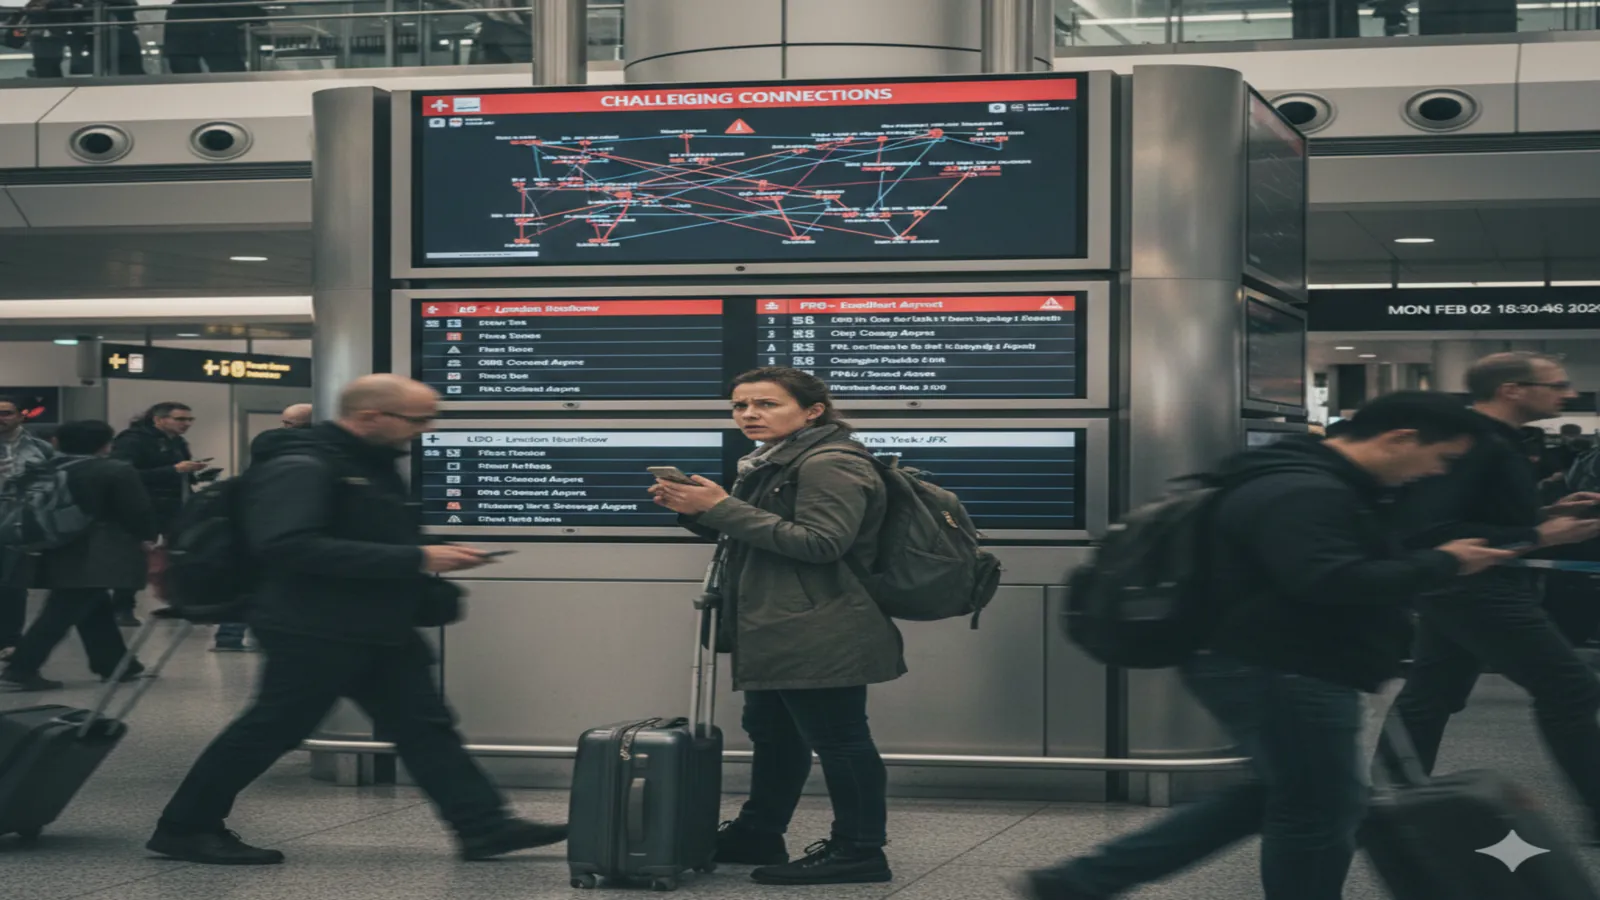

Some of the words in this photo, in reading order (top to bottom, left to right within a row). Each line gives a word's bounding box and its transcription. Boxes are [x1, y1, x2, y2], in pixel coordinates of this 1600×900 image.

[600, 92, 733, 107] CHALLEIGING
[738, 87, 893, 104] CONNECTIONS
[1388, 305, 1430, 314] MON
[1435, 305, 1466, 314] FEB
[1470, 305, 1490, 314] 02
